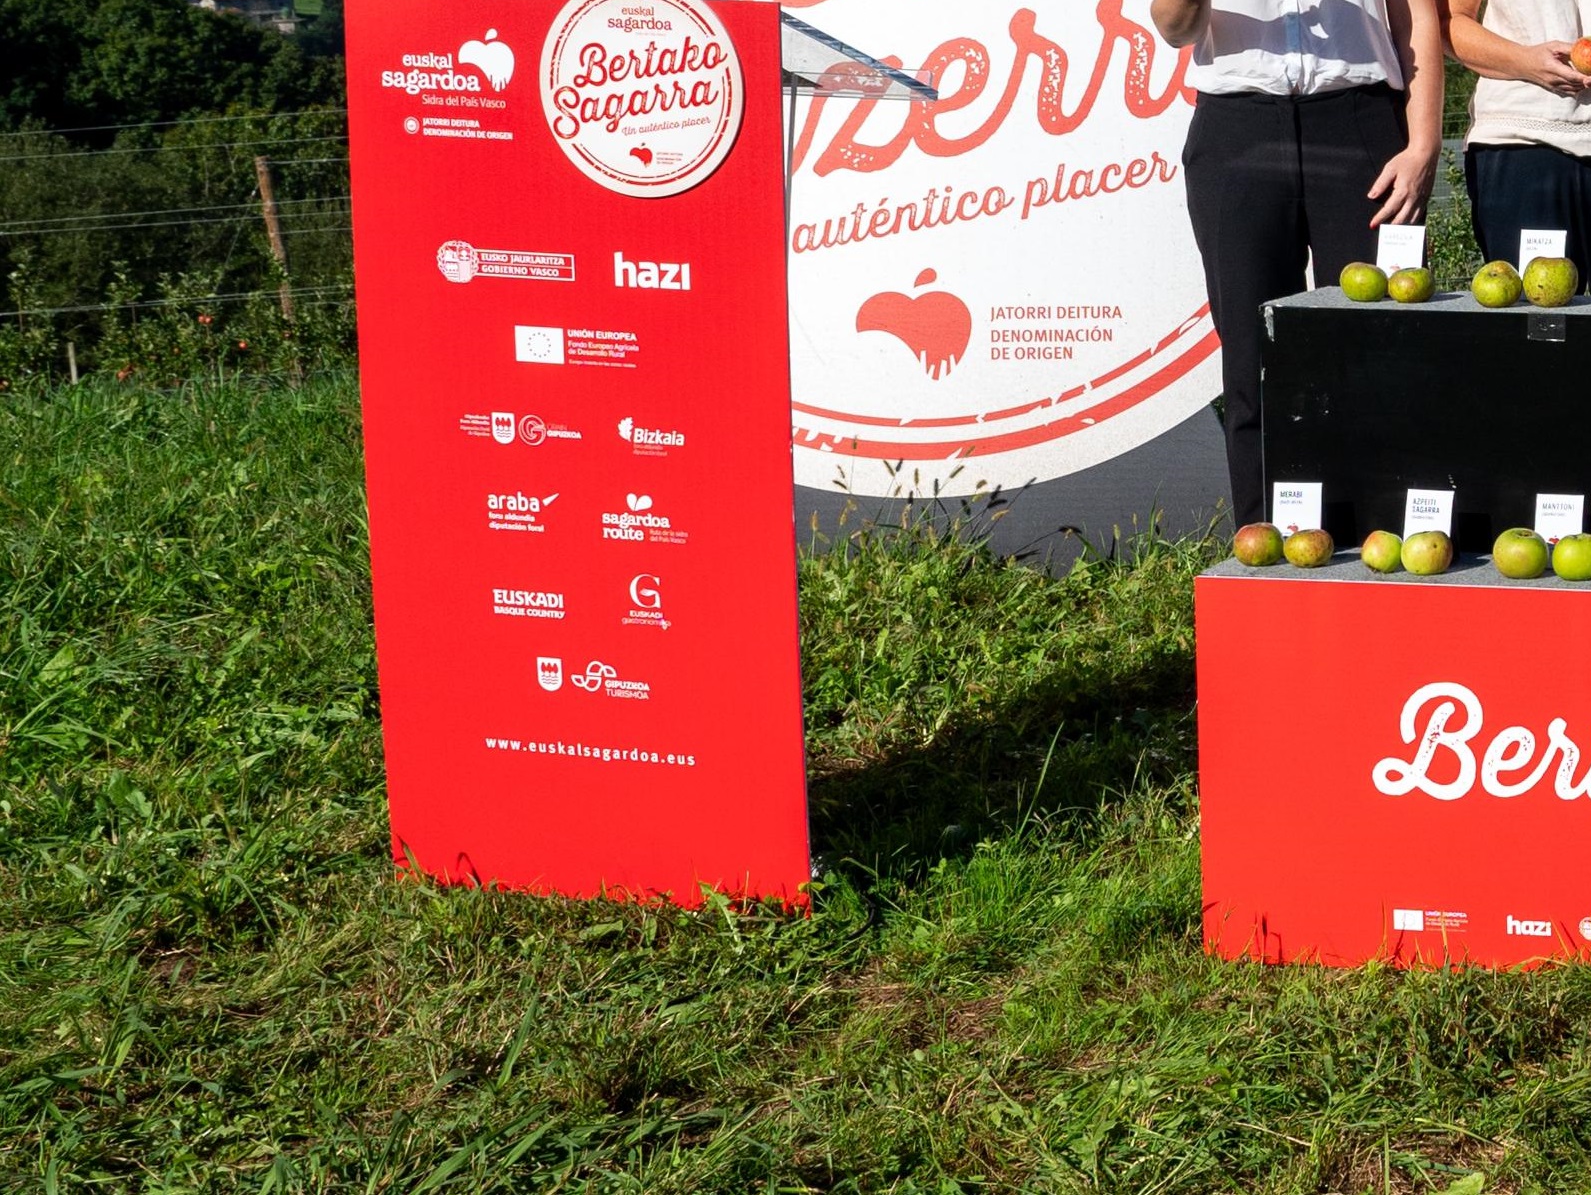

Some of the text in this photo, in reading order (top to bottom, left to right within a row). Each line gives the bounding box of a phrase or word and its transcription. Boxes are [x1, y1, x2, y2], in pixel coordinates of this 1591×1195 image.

[621, 6, 655, 17] euskal
[607, 16, 673, 33] sagardoa
[402, 52, 453, 70] euskal
[573, 36, 728, 88] Bertako
[382, 69, 481, 95] sagardoa
[422, 94, 506, 109] Sidra del País Vasco
[553, 80, 719, 140] Sagarra
[792, 151, 1178, 254] auténtico placer
[481, 253, 565, 266] EUSKO JAURLARITZA
[481, 265, 560, 277] GOBIERNO VASCO
[990, 305, 1122, 322] JATORRI DEITURA
[567, 328, 637, 342] UNIÓN EUROPEA
[991, 325, 1113, 343] DENOMINACIÓN
[991, 346, 1073, 360] DE ORIGEN
[633, 427, 685, 447] Bizkaia
[487, 490, 540, 513] araba
[601, 512, 671, 529] sagardoa
[602, 526, 645, 541] route
[492, 588, 564, 609] EUSKADI
[493, 606, 566, 620] BASQUE COUNTRY
[629, 609, 664, 619] EUSKADI
[604, 679, 651, 692] GIPUZKOA
[605, 688, 650, 700] TURISMOA
[485, 737, 696, 767] www.euskalsagardoa.eus
[1506, 914, 1552, 937] hazi
